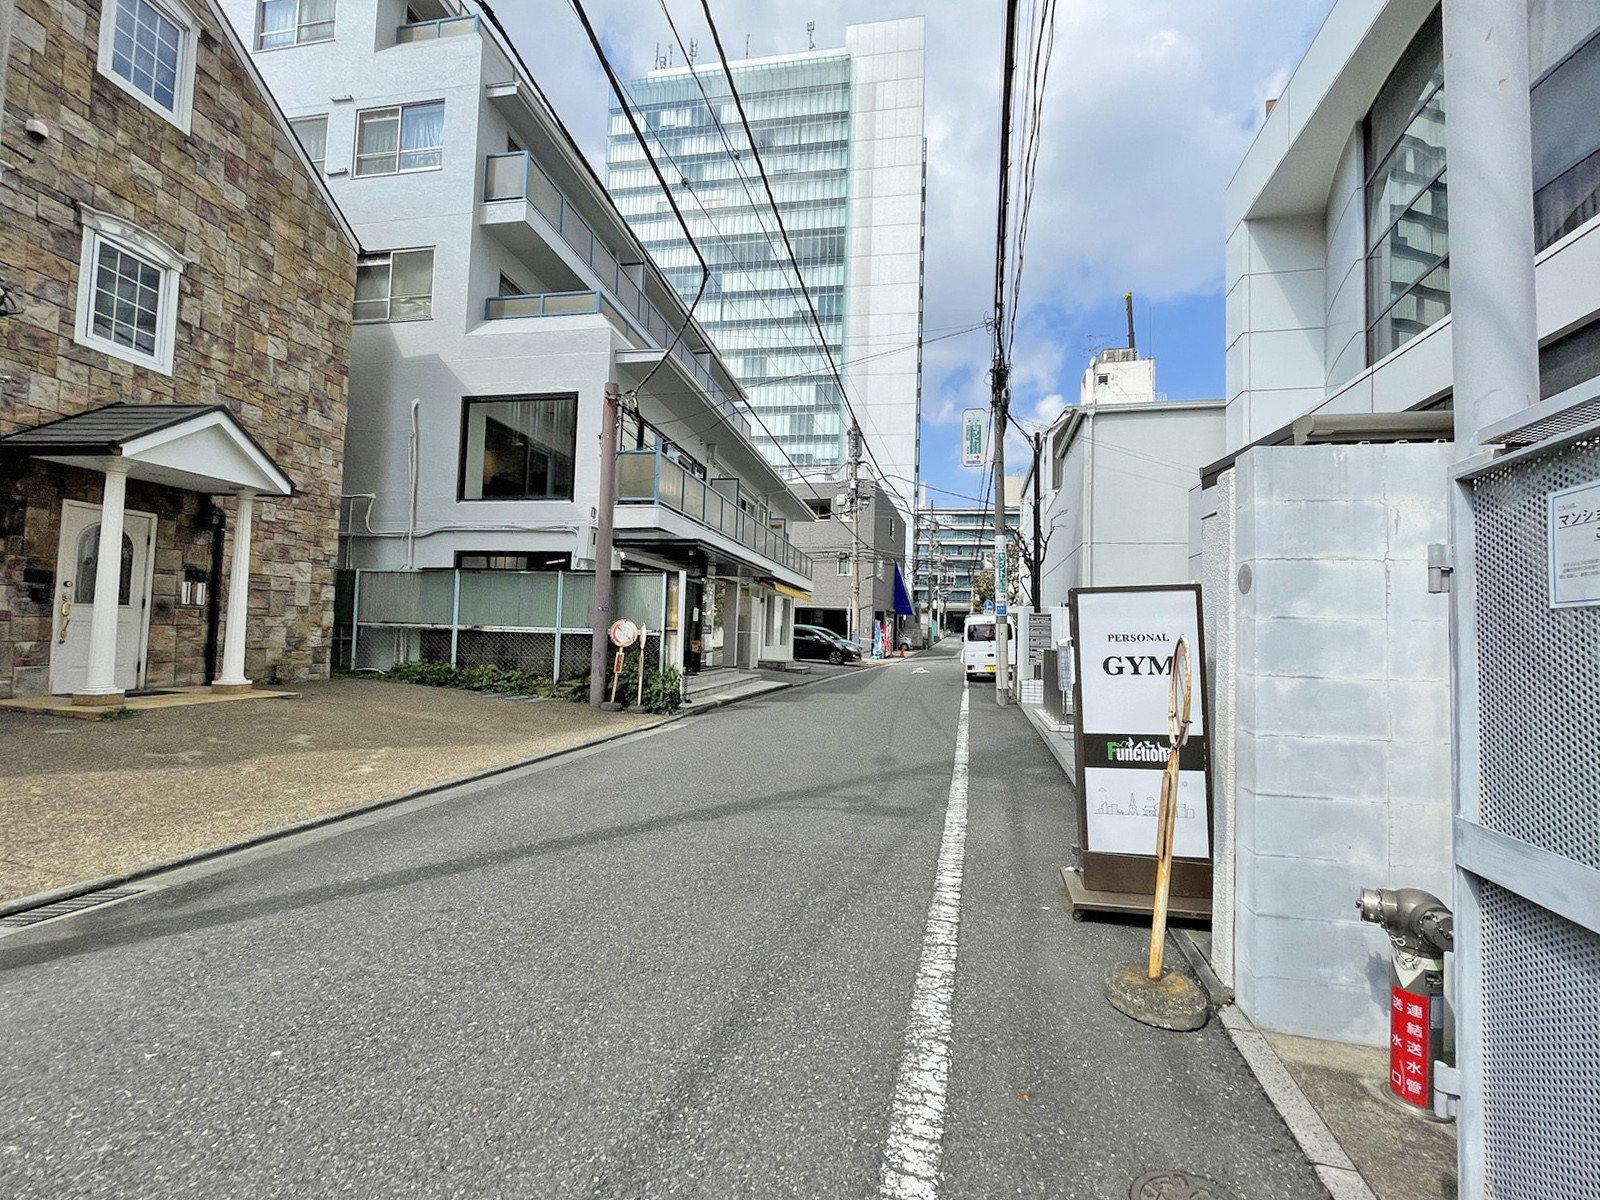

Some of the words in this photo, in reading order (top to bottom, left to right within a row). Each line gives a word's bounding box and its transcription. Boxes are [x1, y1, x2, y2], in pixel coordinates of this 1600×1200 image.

[1107, 633, 1169, 642] PERSONAL
[1103, 655, 1174, 675] GYM
[1107, 741, 1171, 761] Function
[1392, 995, 1403, 1086] 送水口
[1406, 1002, 1423, 1095] 連結送水管
